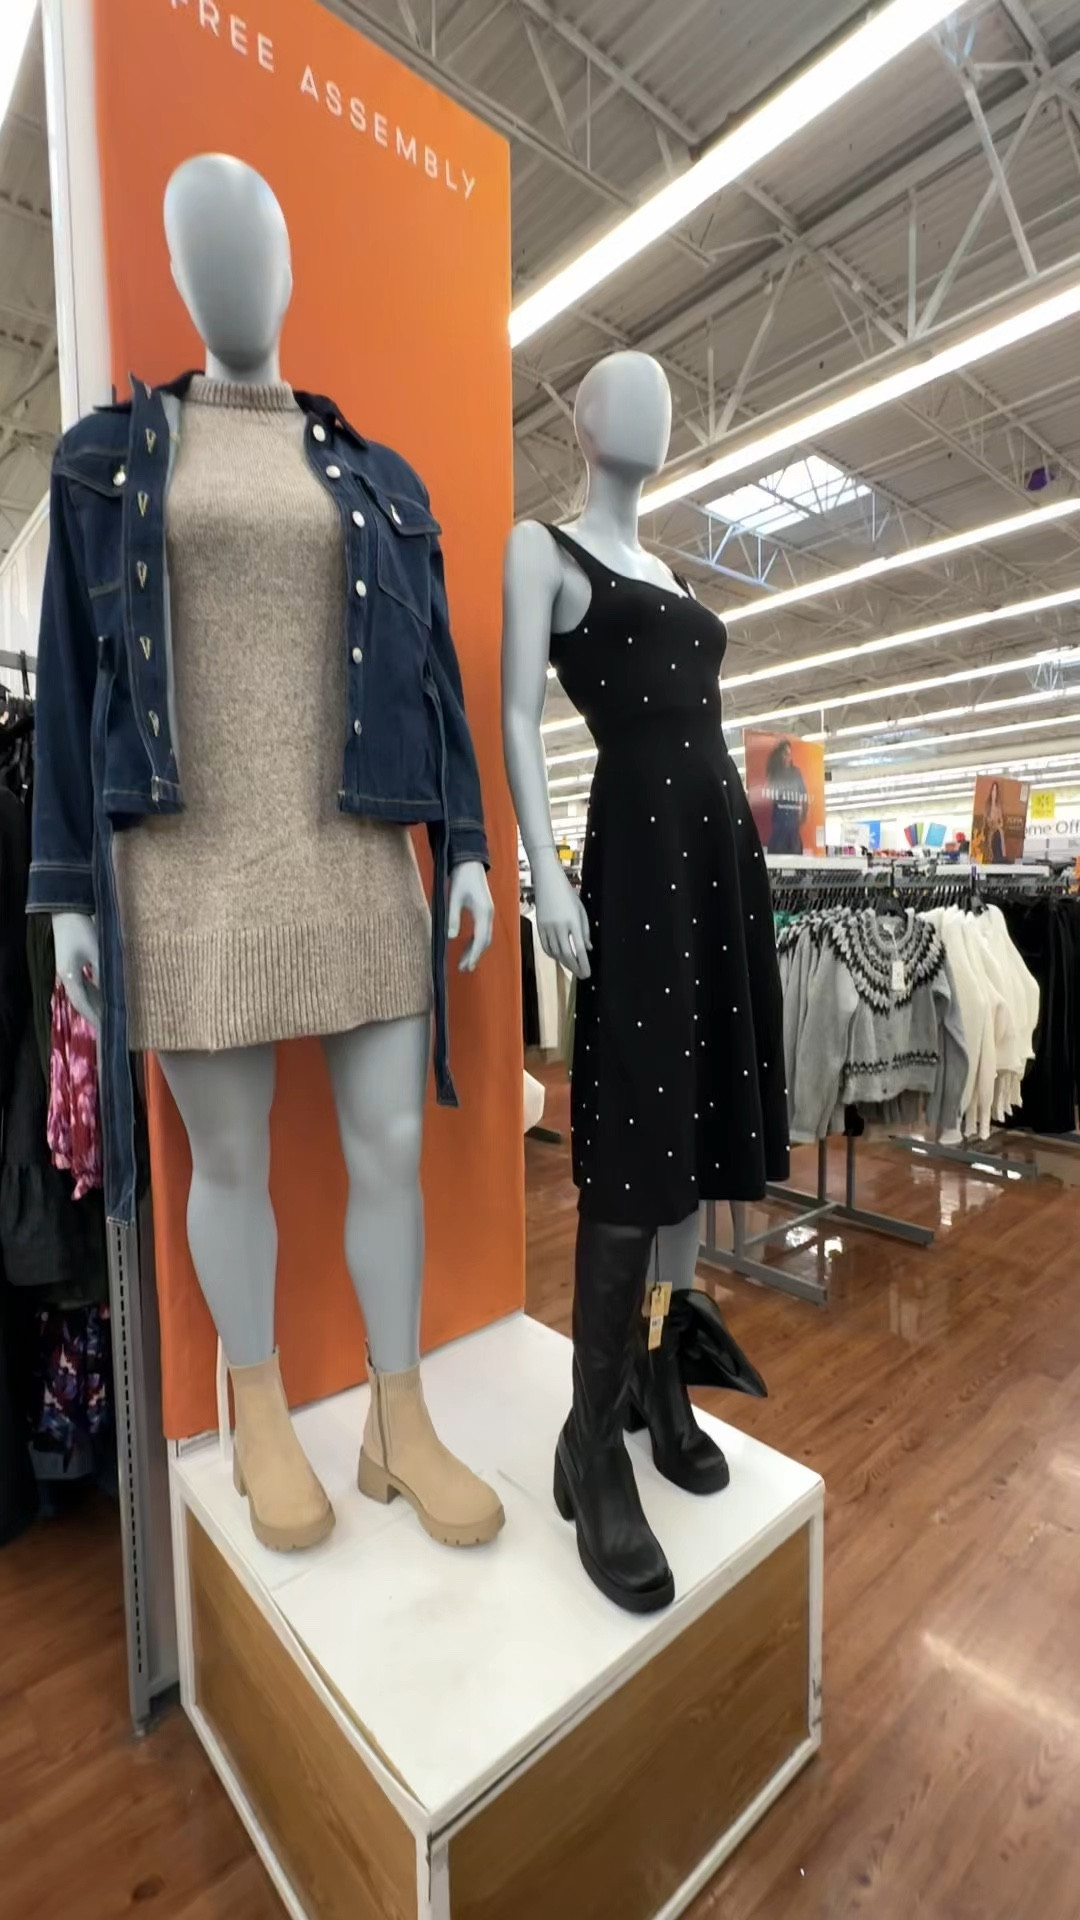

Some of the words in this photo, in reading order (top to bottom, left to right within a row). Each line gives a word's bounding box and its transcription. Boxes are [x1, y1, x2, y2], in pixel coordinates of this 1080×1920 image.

[171, 0, 275, 73] REE
[299, 64, 477, 200] ASSEMBLY
[1025, 823, 1052, 836] me
